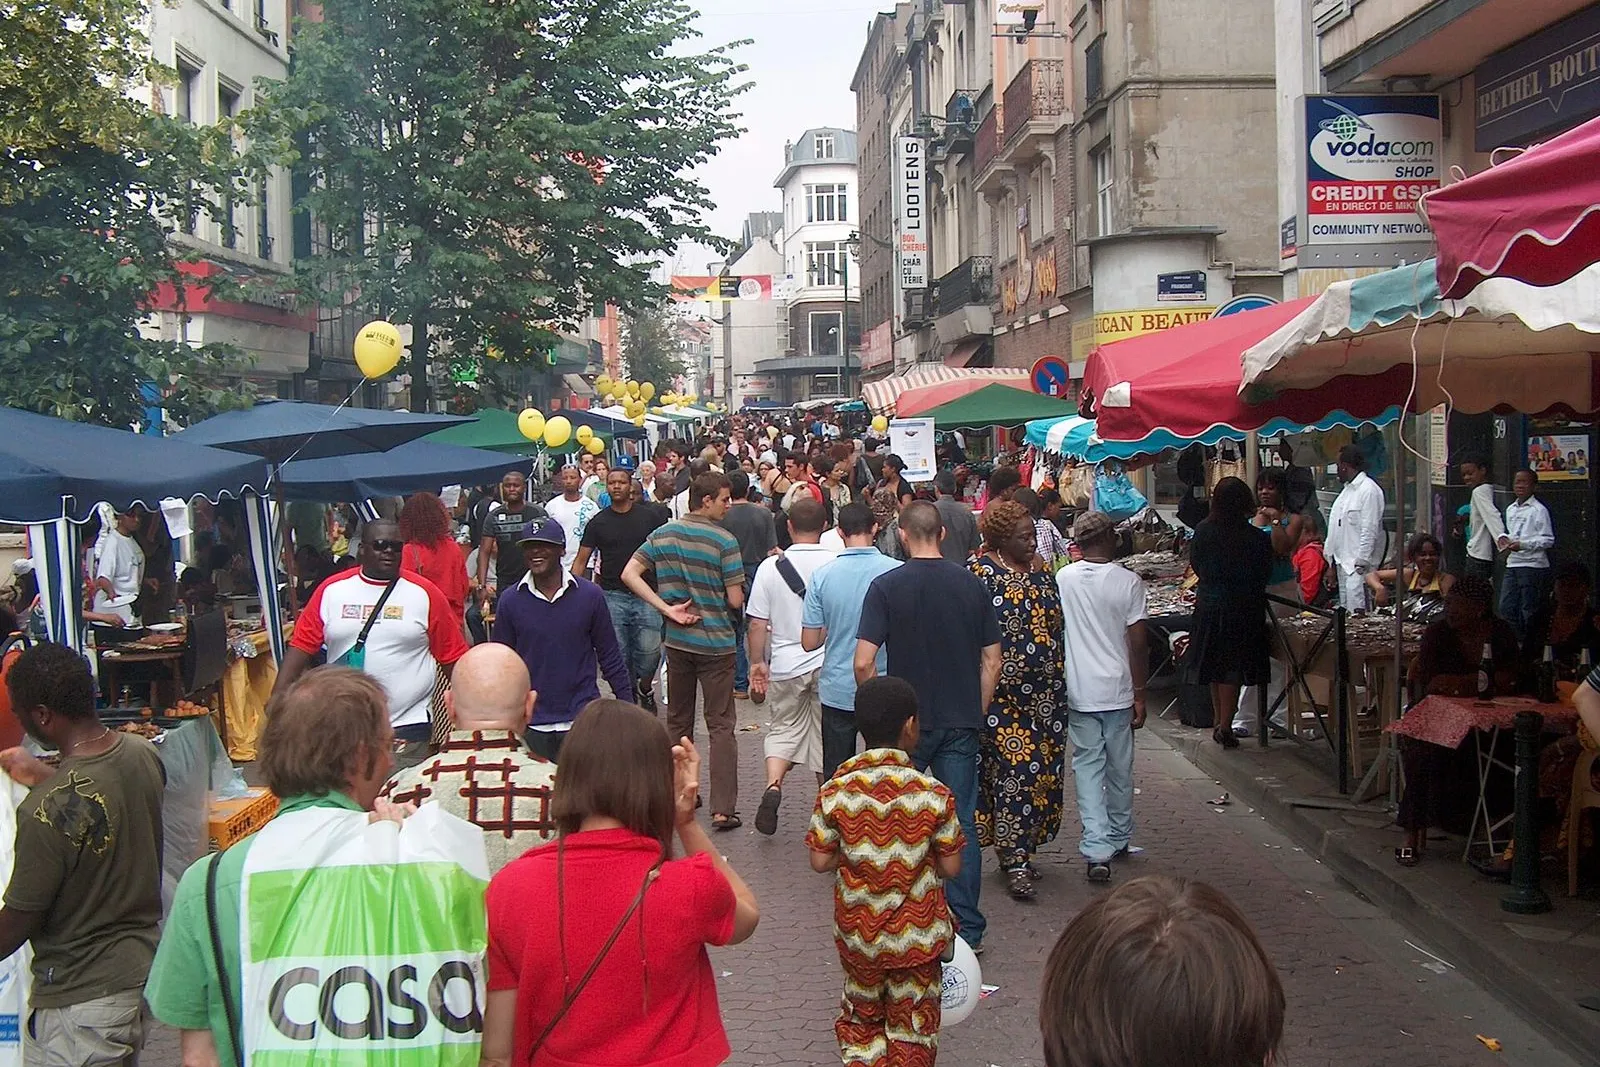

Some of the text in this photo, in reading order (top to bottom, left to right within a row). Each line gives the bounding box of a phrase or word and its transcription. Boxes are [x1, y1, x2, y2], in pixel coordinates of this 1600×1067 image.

[1480, 70, 1543, 118] BETHEL
[1327, 133, 1434, 157] vodacom
[1395, 166, 1434, 178] SHOP
[905, 141, 921, 230] LOOTENS
[1311, 185, 1388, 201] CREDIT
[1326, 202, 1340, 211] EN
[1341, 201, 1377, 211] DIRECT
[1380, 201, 1394, 210] DE
[1312, 223, 1435, 235] COMMUNITY NETWOR
[902, 243, 927, 251] CHERIE
[903, 258, 921, 266] CHAR
[903, 267, 912, 275] CU
[903, 275, 923, 284] TERIE
[268, 960, 483, 1041] casa
